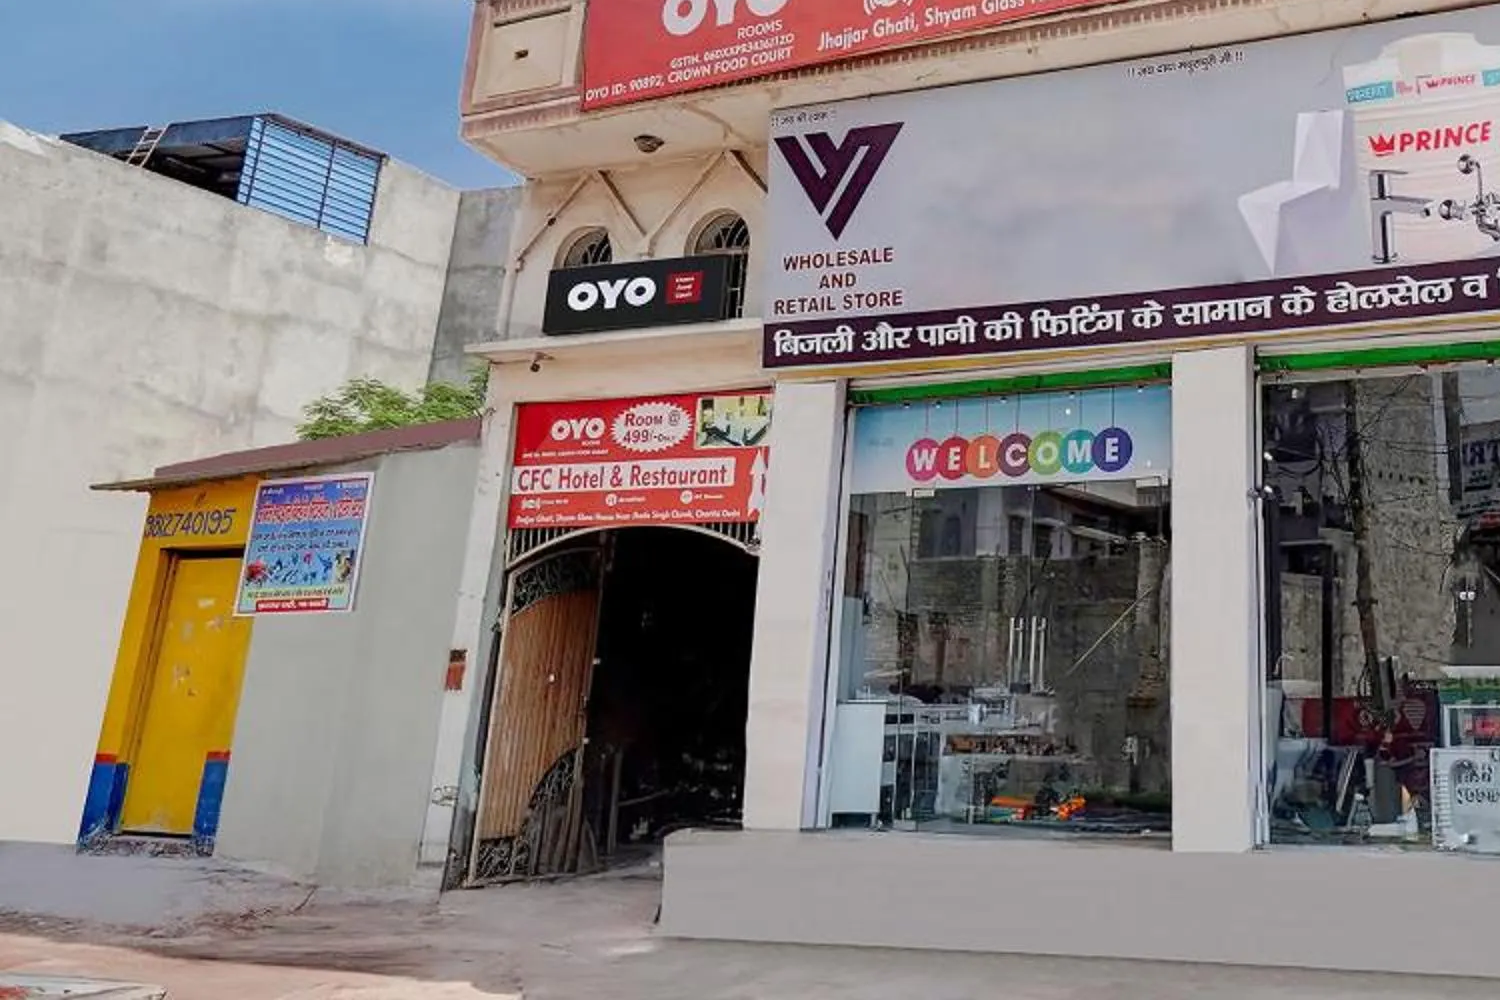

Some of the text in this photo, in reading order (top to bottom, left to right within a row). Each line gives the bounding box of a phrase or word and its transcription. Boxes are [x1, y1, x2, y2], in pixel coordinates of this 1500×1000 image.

[737, 19, 782, 39] ROOMS
[816, 24, 869, 54] Jhajjar
[924, 1, 977, 33] Shyam
[586, 87, 609, 101] OYO
[667, 64, 711, 84] CROWN
[713, 56, 749, 74] FOOD
[751, 46, 793, 66] COURT
[1399, 121, 1492, 153] PRINCE
[783, 247, 894, 271] WHOLESALE
[567, 276, 656, 311] OYO
[818, 271, 857, 290] AND
[773, 289, 903, 316] RETAIL STORE
[774, 318, 854, 358] बिजली
[862, 313, 912, 352] और
[916, 314, 975, 349] पानी
[984, 309, 1023, 341] की
[1030, 302, 1124, 338] फिटिंग
[1131, 303, 1163, 331] के
[1173, 289, 1272, 326] सामान
[1281, 285, 1316, 317] के
[1326, 274, 1455, 315] होलसेल
[1461, 272, 1488, 300] व
[551, 416, 605, 441] OYO
[911, 436, 1121, 473] WELCOME
[518, 463, 728, 491] CFC Hotel & Restaurant
